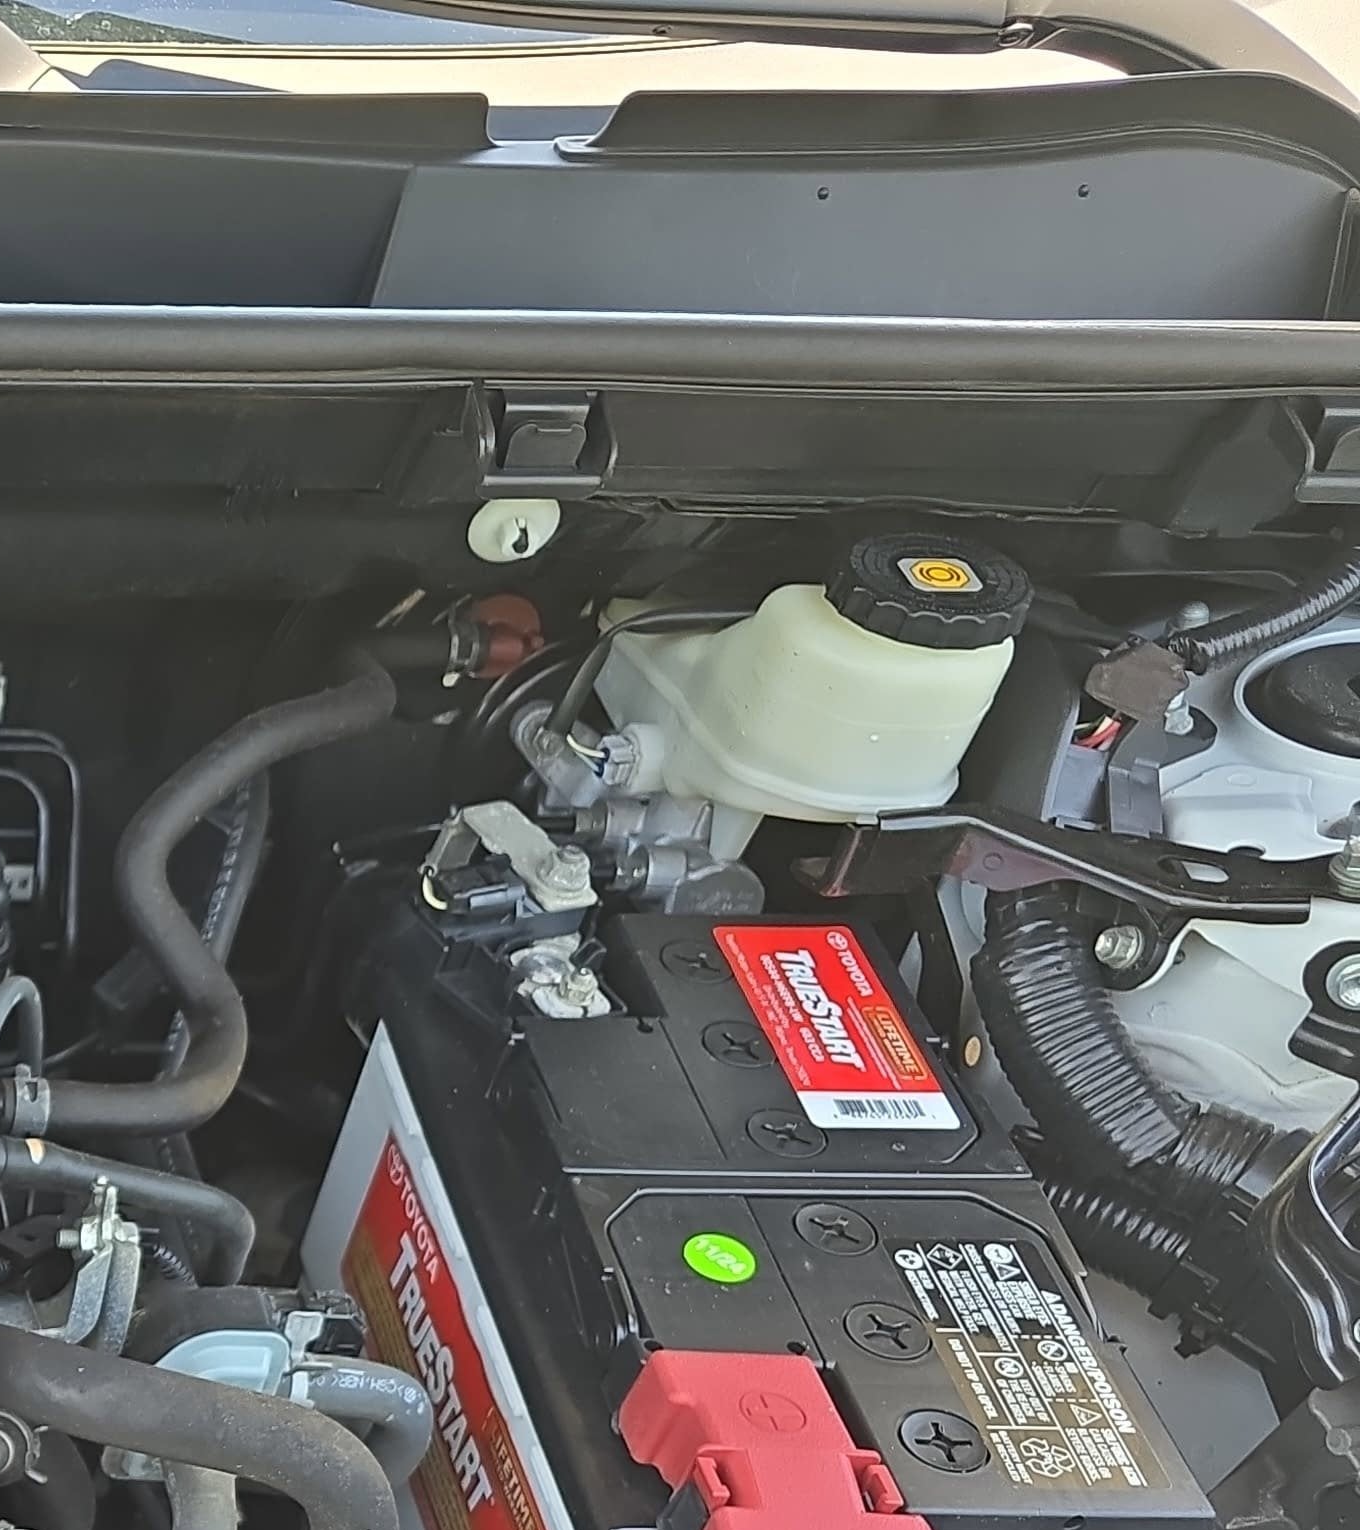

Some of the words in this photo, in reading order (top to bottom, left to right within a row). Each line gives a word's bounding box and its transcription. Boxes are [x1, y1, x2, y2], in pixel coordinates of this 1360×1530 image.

[837, 949, 874, 996] TOYOTA
[399, 1181, 439, 1284] TOYOTA
[1046, 1303, 1137, 1433] DANGER/POISON
